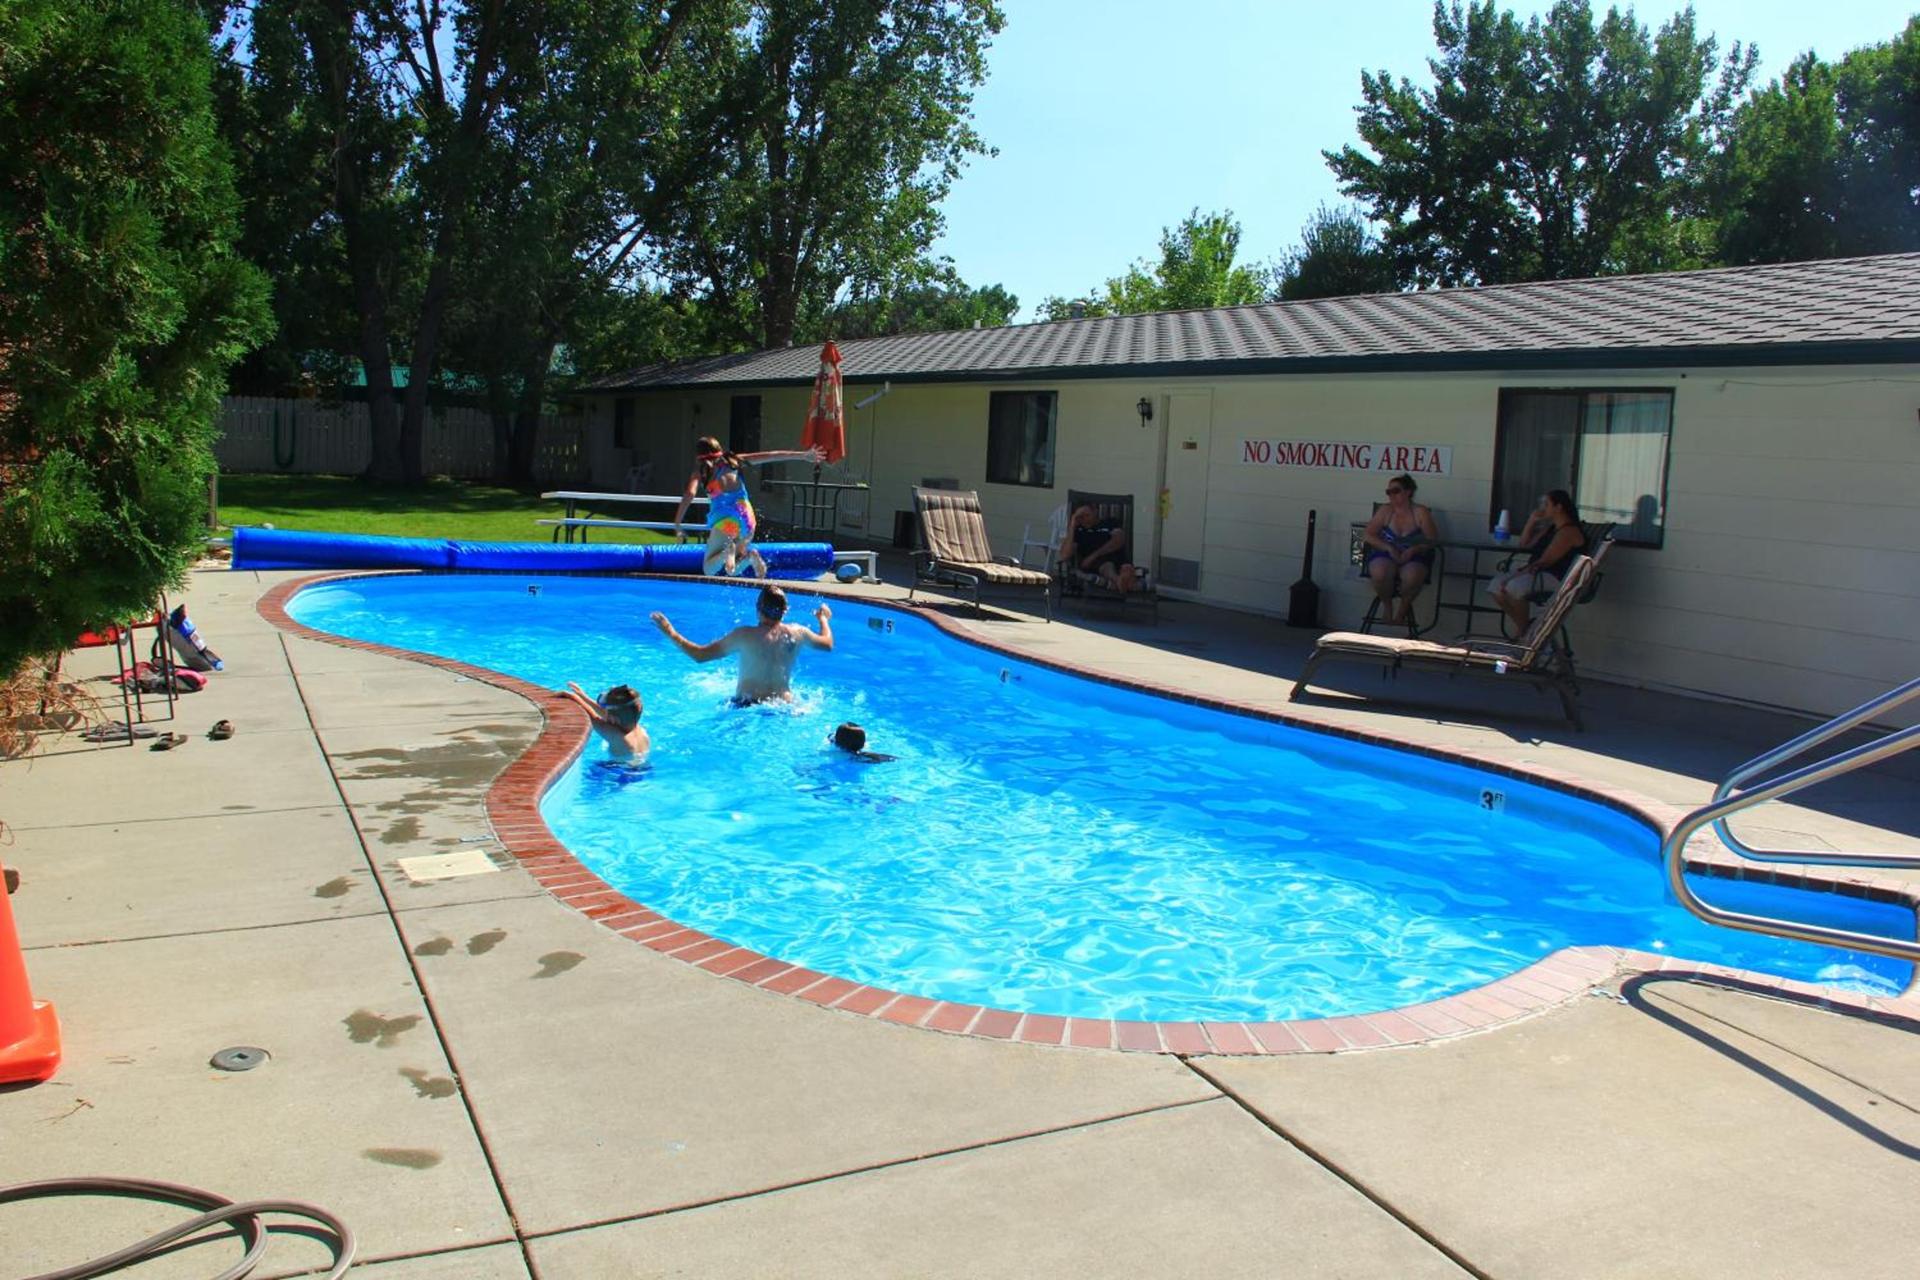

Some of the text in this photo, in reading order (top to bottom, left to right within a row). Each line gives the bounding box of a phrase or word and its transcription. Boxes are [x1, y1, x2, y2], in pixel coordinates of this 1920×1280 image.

[1243, 440, 1443, 473] NO SMOKING AREA
